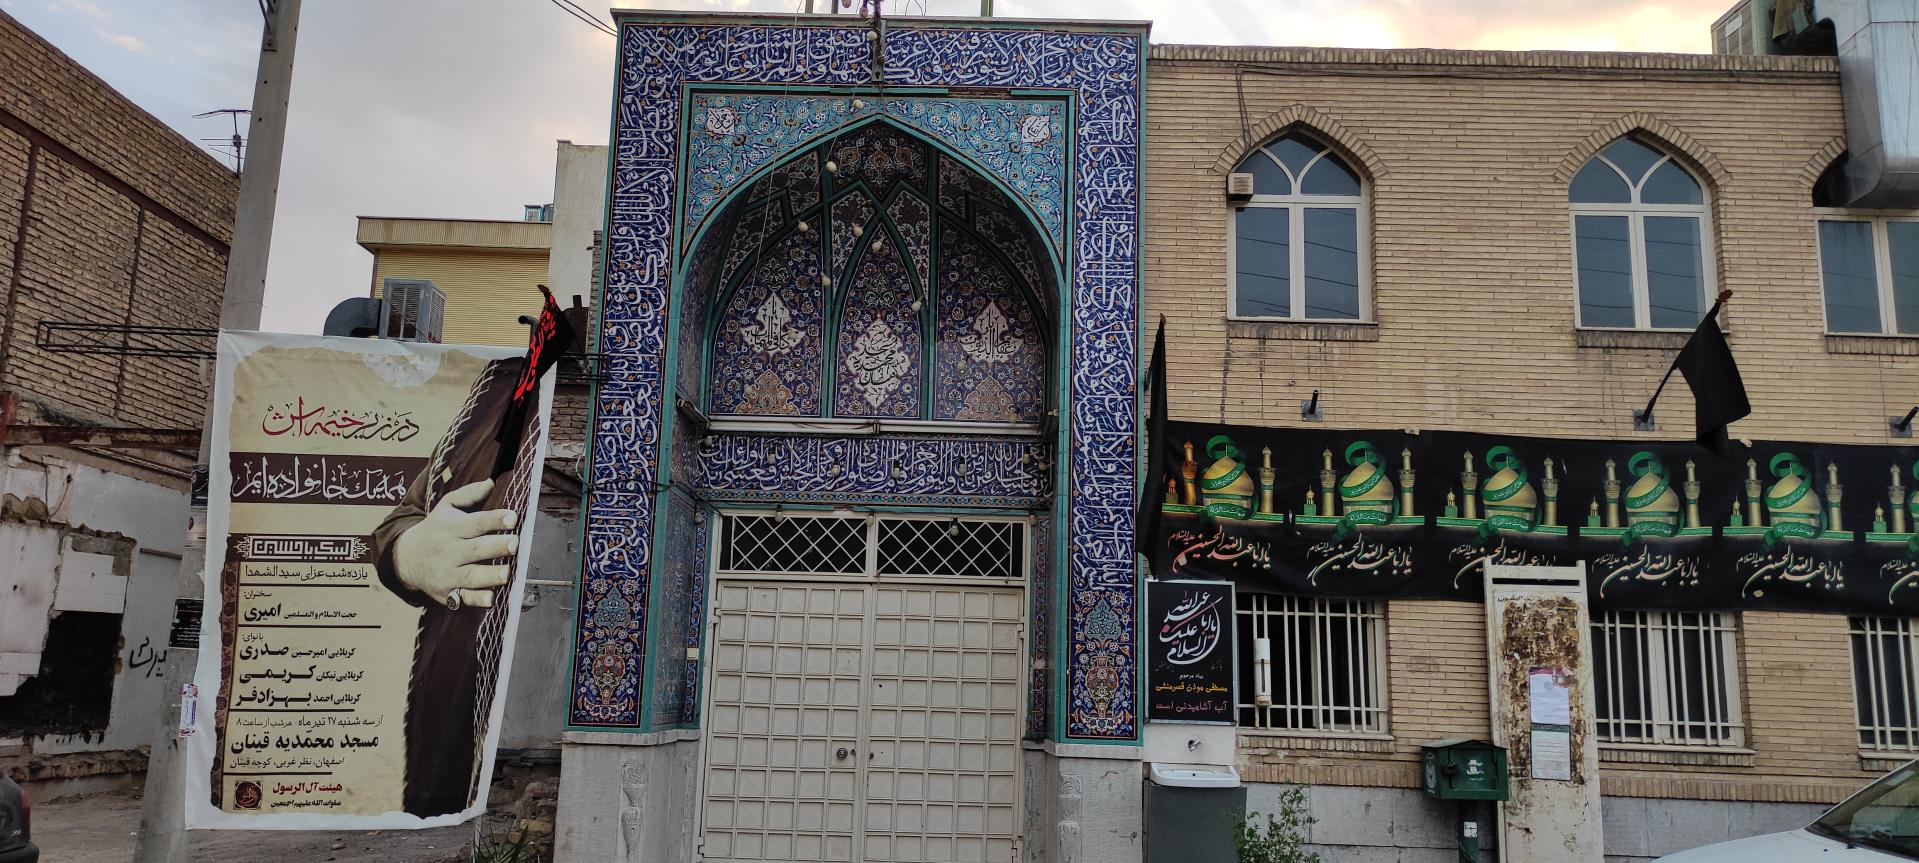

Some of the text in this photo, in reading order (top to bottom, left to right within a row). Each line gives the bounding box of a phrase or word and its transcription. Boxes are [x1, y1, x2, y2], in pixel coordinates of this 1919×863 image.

[325, 568, 347, 581] شب
[347, 566, 368, 581] یازده
[244, 602, 282, 622] امیری
[239, 642, 289, 661] صدری
[328, 647, 356, 659] کربلایی
[239, 664, 317, 684] کریمی
[335, 670, 364, 682] کربلایی
[313, 694, 333, 703] احمد
[333, 693, 361, 705] کربلایی
[1214, 700, 1228, 714] آب
[230, 731, 270, 755] قینان
[340, 733, 380, 753] مسجد
[229, 757, 251, 769] قینان
[251, 757, 273, 768] کوچه
[298, 757, 313, 768] نظر
[272, 781, 306, 795] الرسول
